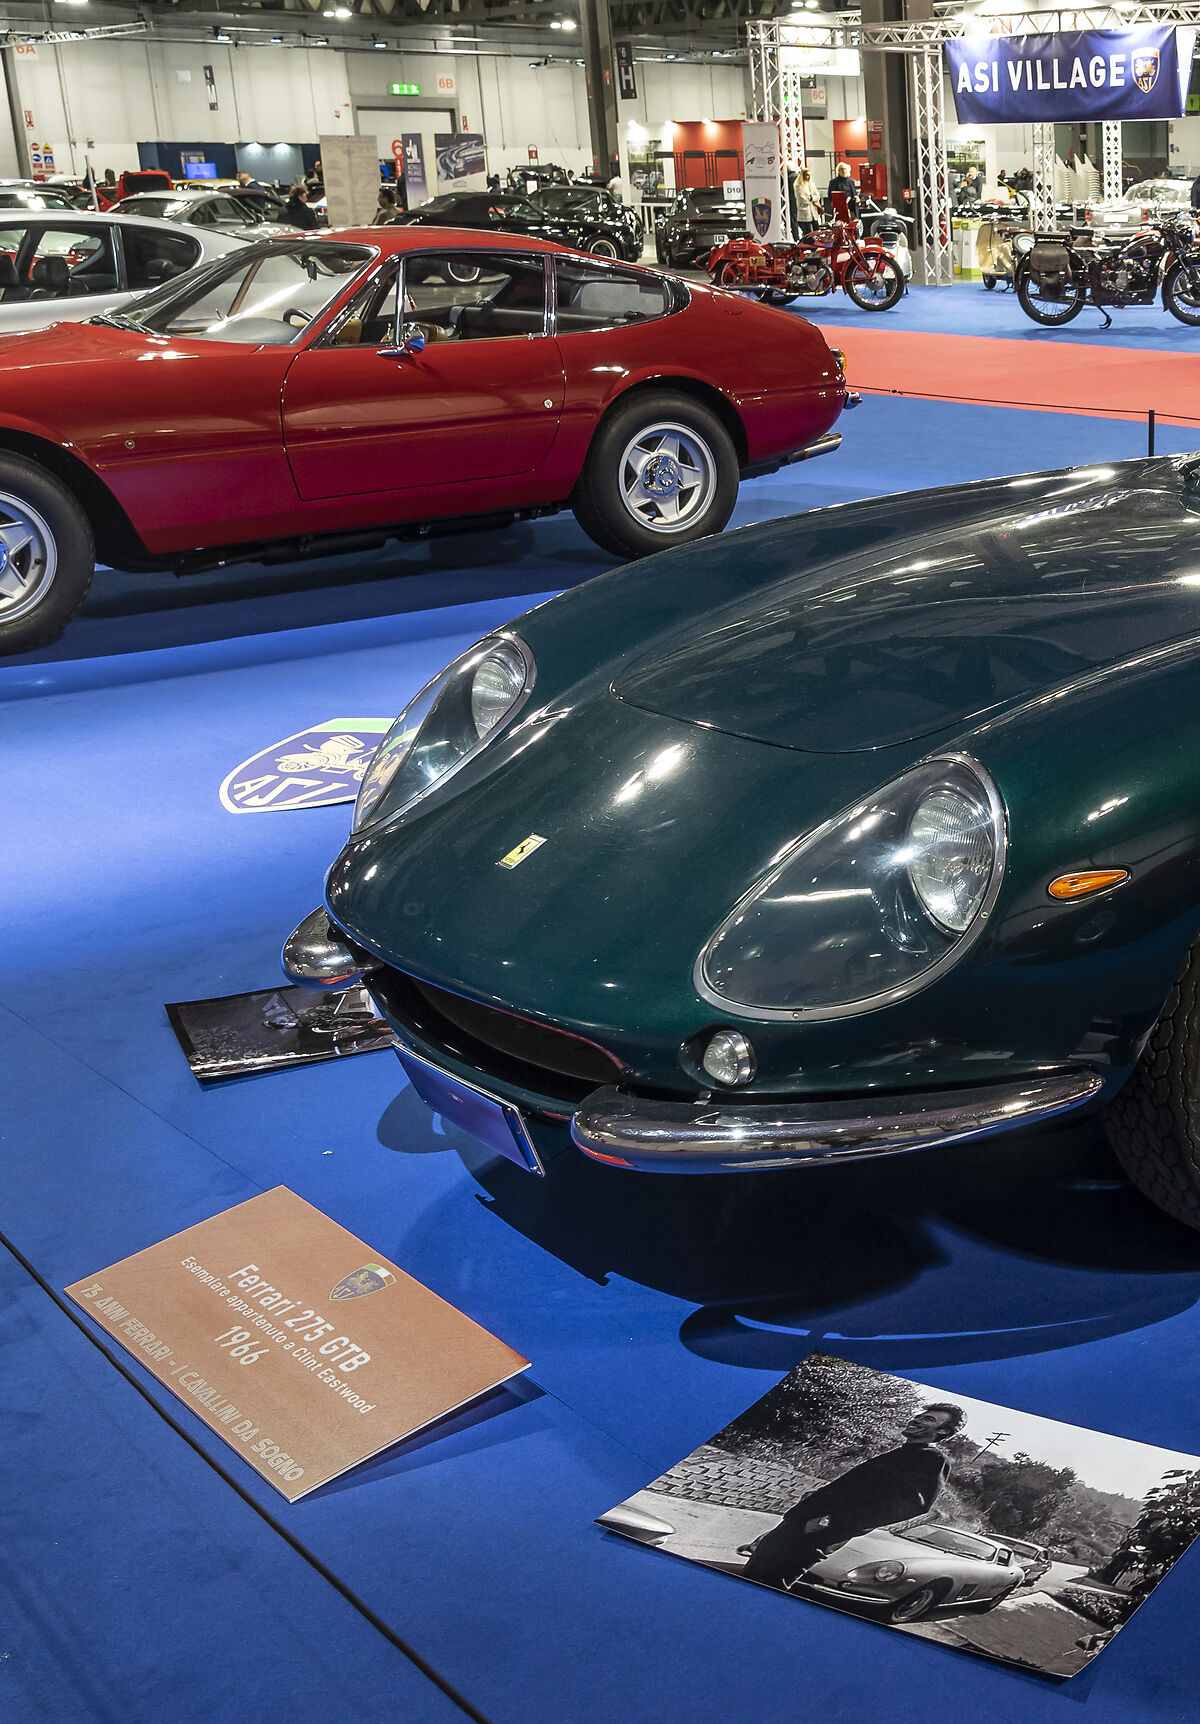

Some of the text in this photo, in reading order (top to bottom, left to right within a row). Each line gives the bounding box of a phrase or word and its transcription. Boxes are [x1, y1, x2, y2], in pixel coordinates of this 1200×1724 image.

[438, 78, 453, 89] 6B
[620, 66, 635, 90] H
[956, 54, 1127, 94] ASI VILLAGE
[233, 774, 349, 807] ASI
[180, 1256, 377, 1414] Esemplare appartenuto a Clint Eastwood
[227, 1263, 371, 1372] Ferrari 275 GTB
[214, 1325, 270, 1365] 1966
[80, 1283, 105, 1299] 75
[93, 1296, 131, 1322] ANNI
[119, 1317, 175, 1362] FERRARI
[178, 1371, 243, 1425] CAVALLINI
[231, 1419, 260, 1443] DA
[250, 1438, 305, 1481] SOGNO
